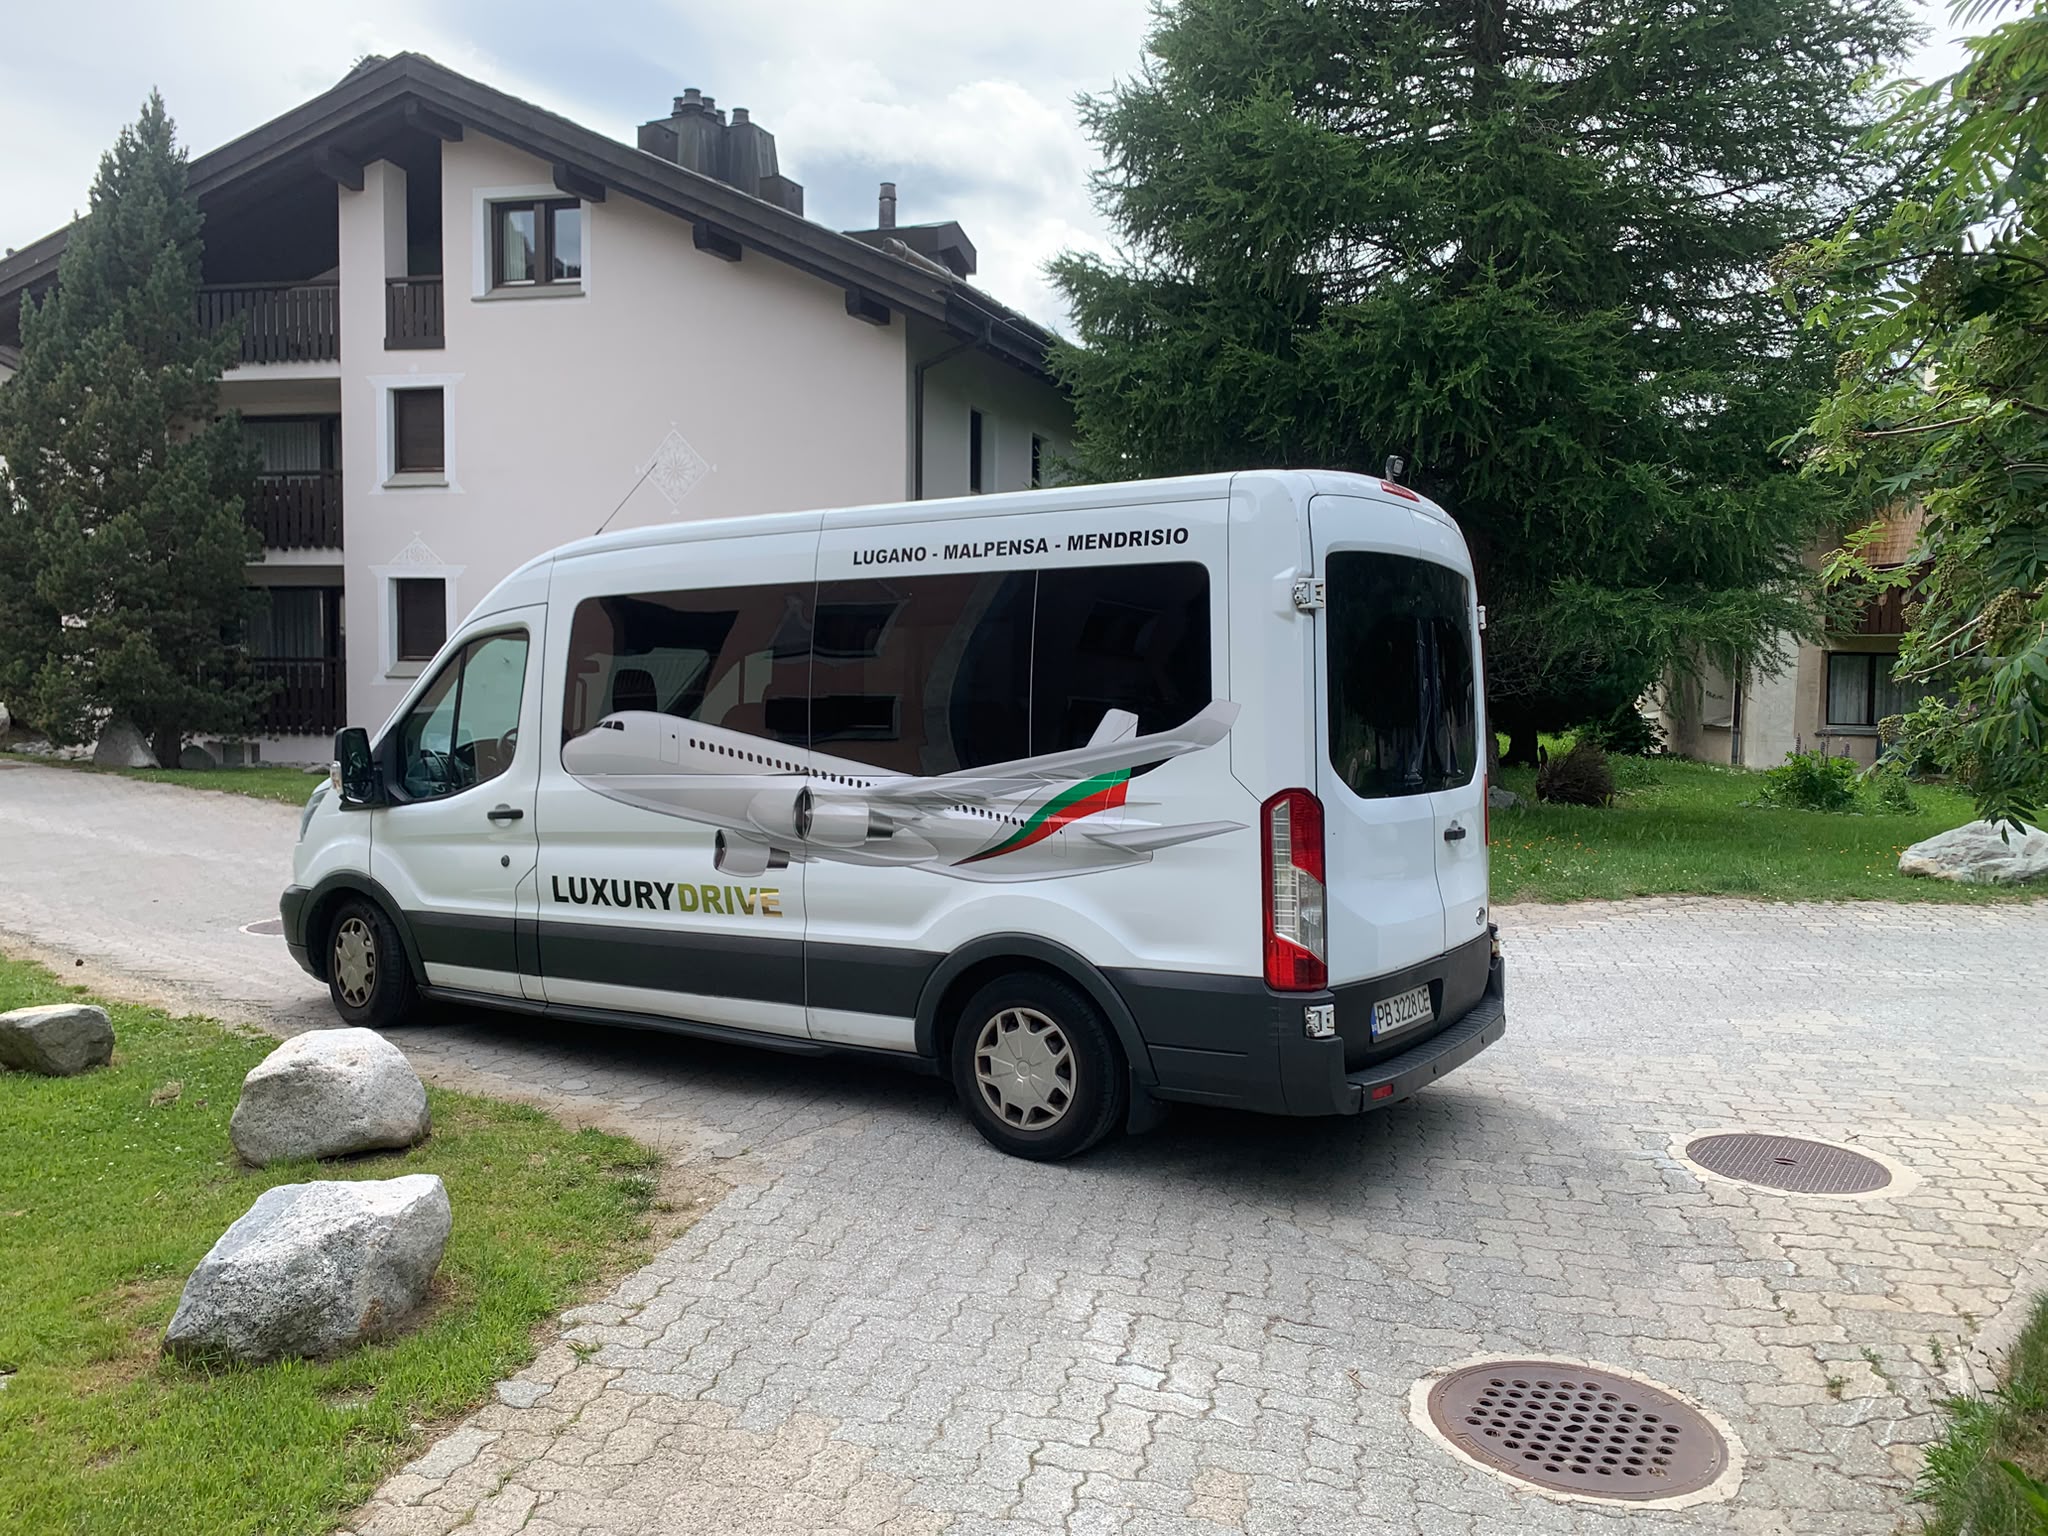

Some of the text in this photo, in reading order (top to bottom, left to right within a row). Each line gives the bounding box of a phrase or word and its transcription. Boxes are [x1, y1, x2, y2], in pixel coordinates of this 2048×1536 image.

[853, 546, 927, 565] LUGANO
[943, 537, 1049, 560] MALPENSA
[1067, 527, 1189, 551] MENDRISIO
[1377, 987, 1430, 1030] PB 3228 CE
